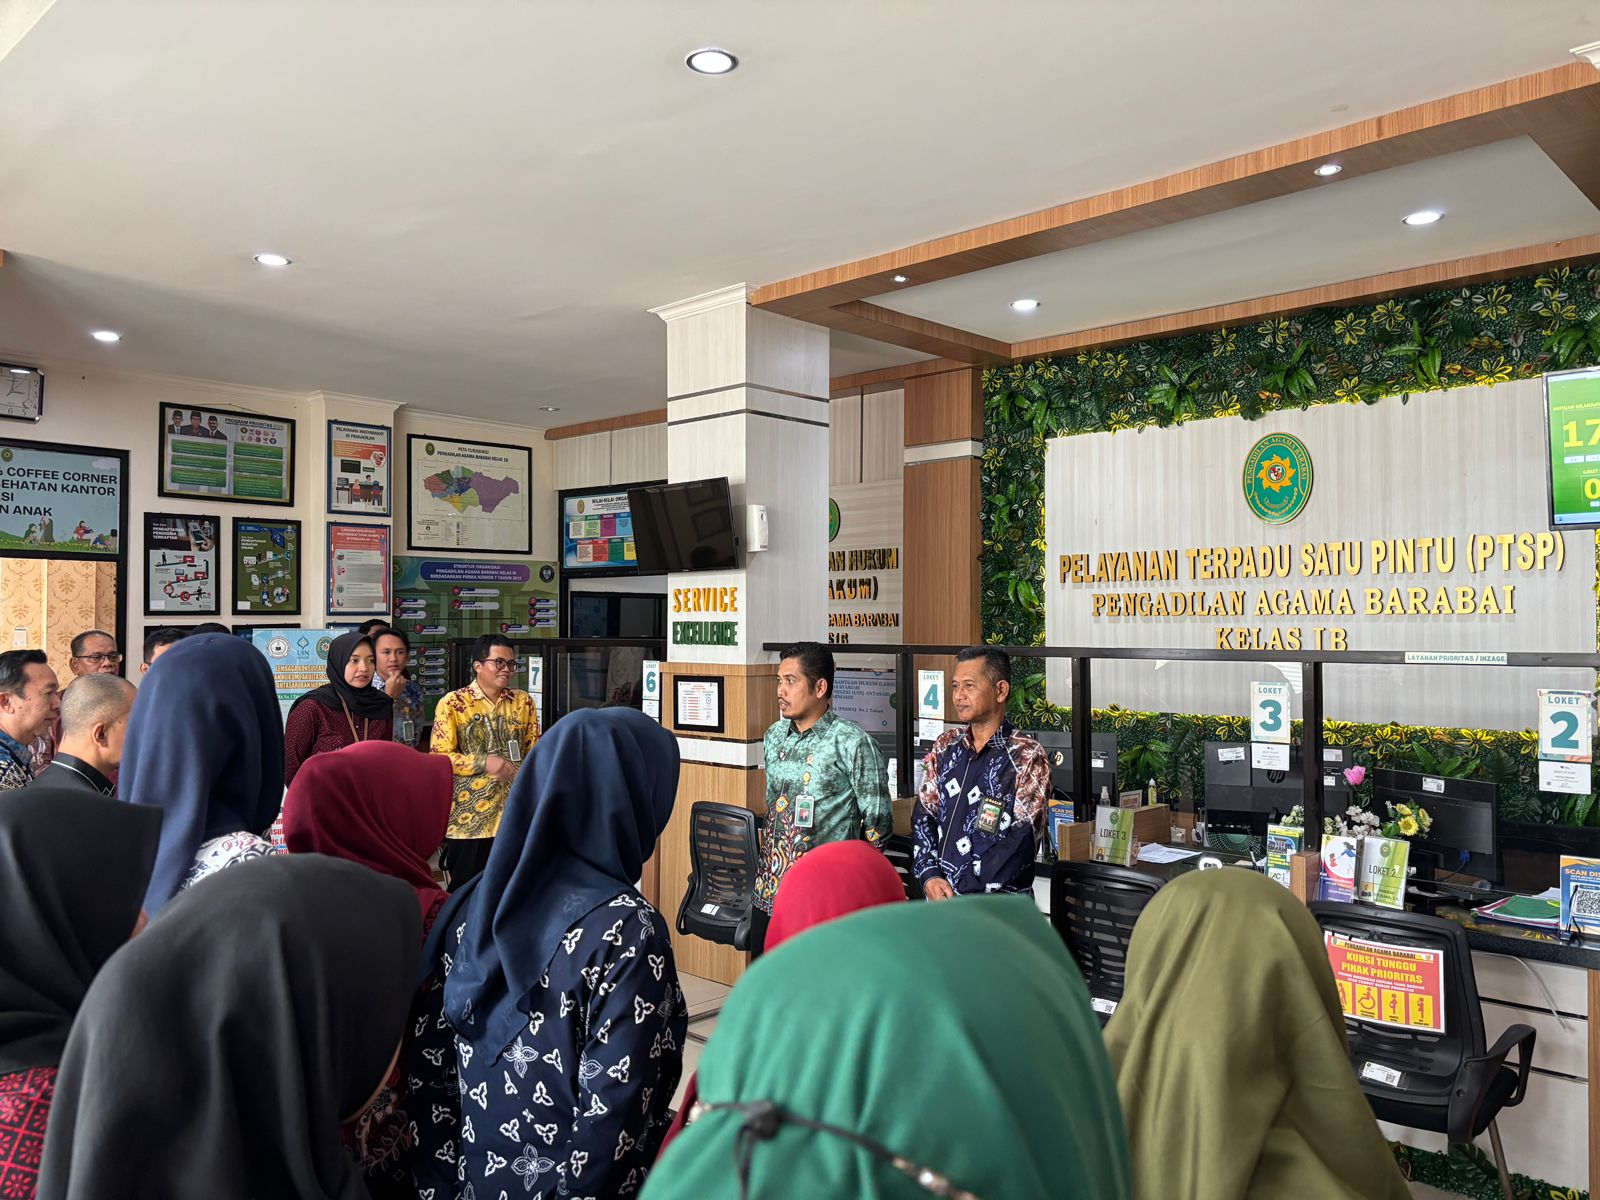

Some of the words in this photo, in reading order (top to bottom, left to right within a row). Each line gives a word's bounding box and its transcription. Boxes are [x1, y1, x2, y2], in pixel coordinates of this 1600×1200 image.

[7, 467, 60, 480] COFFEE
[62, 471, 117, 484] CORNER
[0, 480, 57, 492] EHATAN
[61, 483, 115, 496] KANTOR
[13, 505, 52, 516] ANAK
[848, 547, 899, 571] HUKUM
[1060, 549, 1178, 583] PELAYANAN
[1186, 543, 1291, 580] TERPADU
[1301, 541, 1362, 577] SATU
[1371, 536, 1455, 574] PINTU
[1467, 530, 1565, 573] (PTSP)
[673, 587, 738, 612] SERVICE
[1092, 591, 1245, 617] PENGADILAN
[1254, 588, 1355, 616] AGAMA
[1364, 585, 1515, 615] BARABAI
[853, 612, 899, 627] BARABAI
[672, 621, 738, 646] EXCELLENCE
[1216, 627, 1302, 650] KELAS
[1313, 627, 1347, 650] IB
[531, 666, 540, 685] 7
[646, 671, 656, 693] 6
[924, 684, 940, 710] 4
[1548, 696, 1580, 705] LOKET
[1259, 699, 1282, 732] 3
[1549, 711, 1579, 749] 2
[1100, 828, 1120, 839] LOKET
[1121, 831, 1127, 840] 3
[1369, 864, 1390, 876] LOKET
[1565, 868, 1587, 876] SCAN
[1345, 942, 1373, 953] PENGADILAN
[1374, 948, 1392, 956] AGAMA
[1392, 951, 1416, 959] BARABAI
[1346, 952, 1374, 966] KURSI
[1376, 957, 1417, 972] TUNGGU
[1341, 962, 1370, 976] PIHAK
[1371, 967, 1423, 984] PRIORITAS
